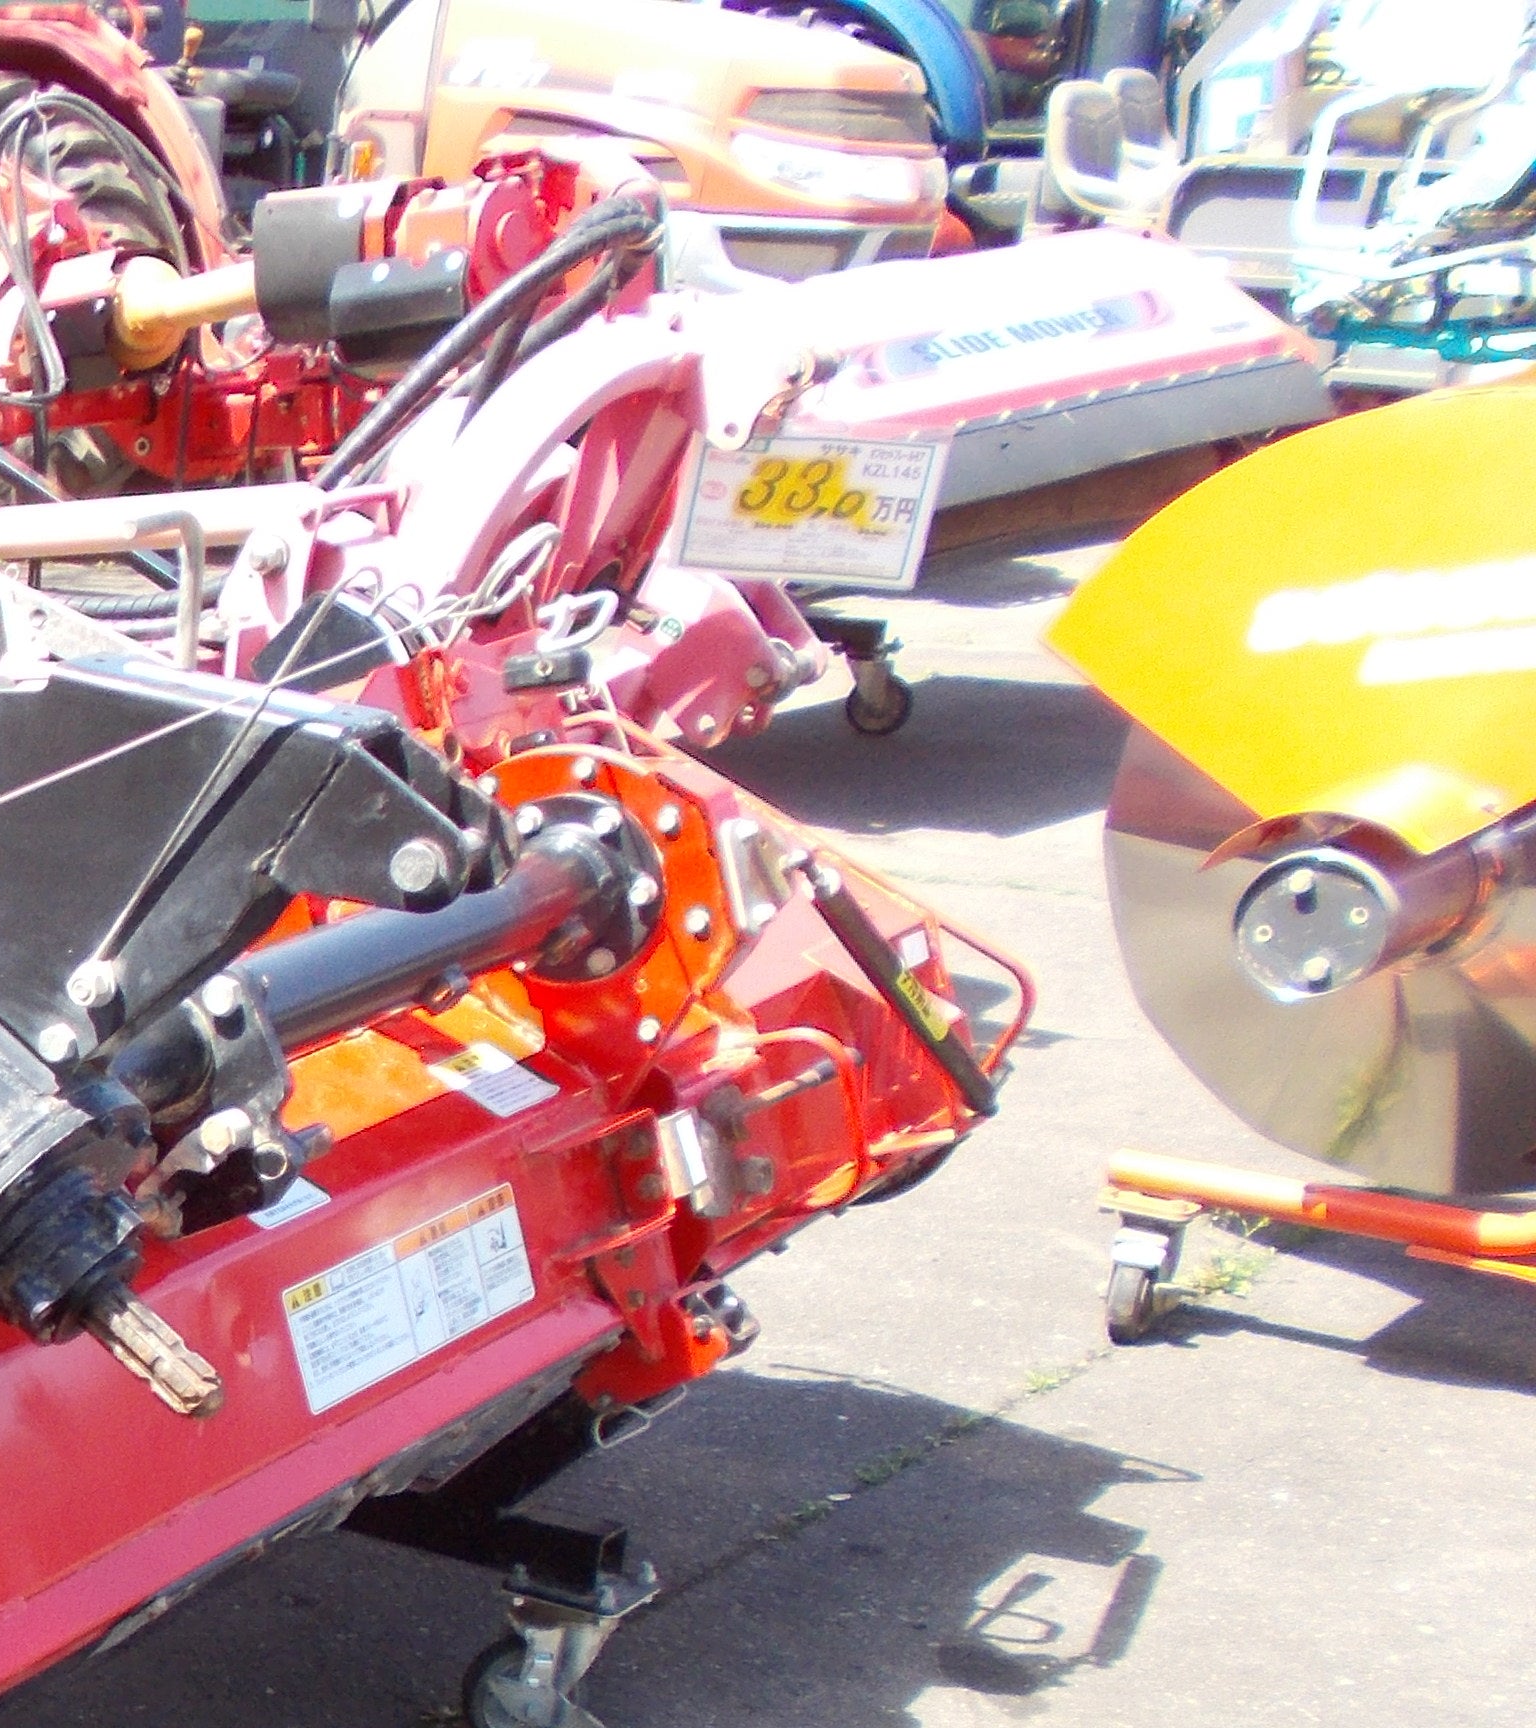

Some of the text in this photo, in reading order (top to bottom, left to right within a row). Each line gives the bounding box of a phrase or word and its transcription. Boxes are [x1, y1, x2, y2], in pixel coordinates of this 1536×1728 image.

[911, 306, 1124, 367] SLIDE MOWER
[872, 494, 917, 524] 万円
